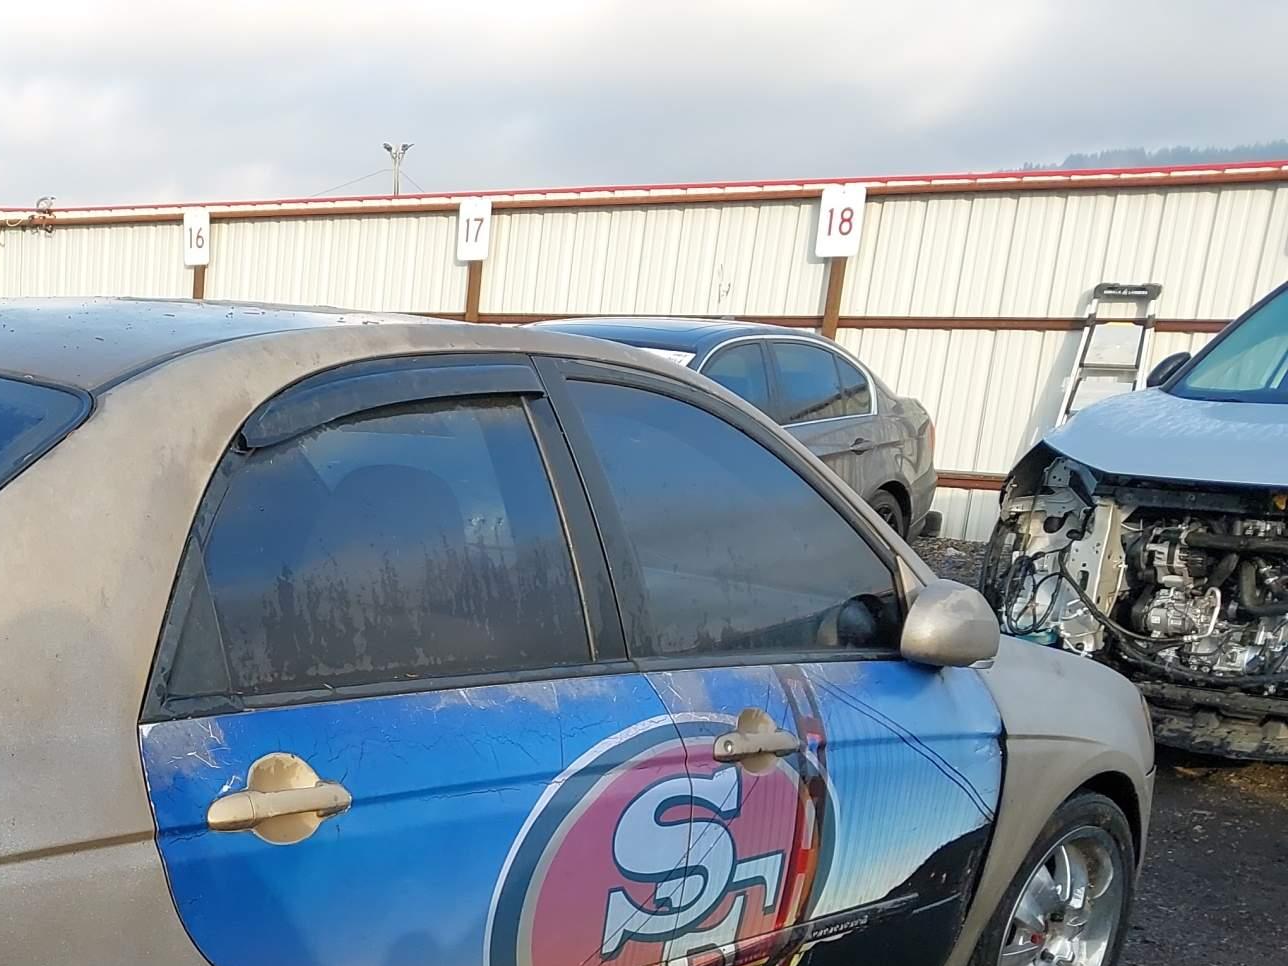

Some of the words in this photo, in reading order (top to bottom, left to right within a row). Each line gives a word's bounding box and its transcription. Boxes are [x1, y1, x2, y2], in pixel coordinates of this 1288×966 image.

[465, 217, 484, 243] 17
[827, 207, 854, 236] 18
[189, 227, 205, 249] 16
